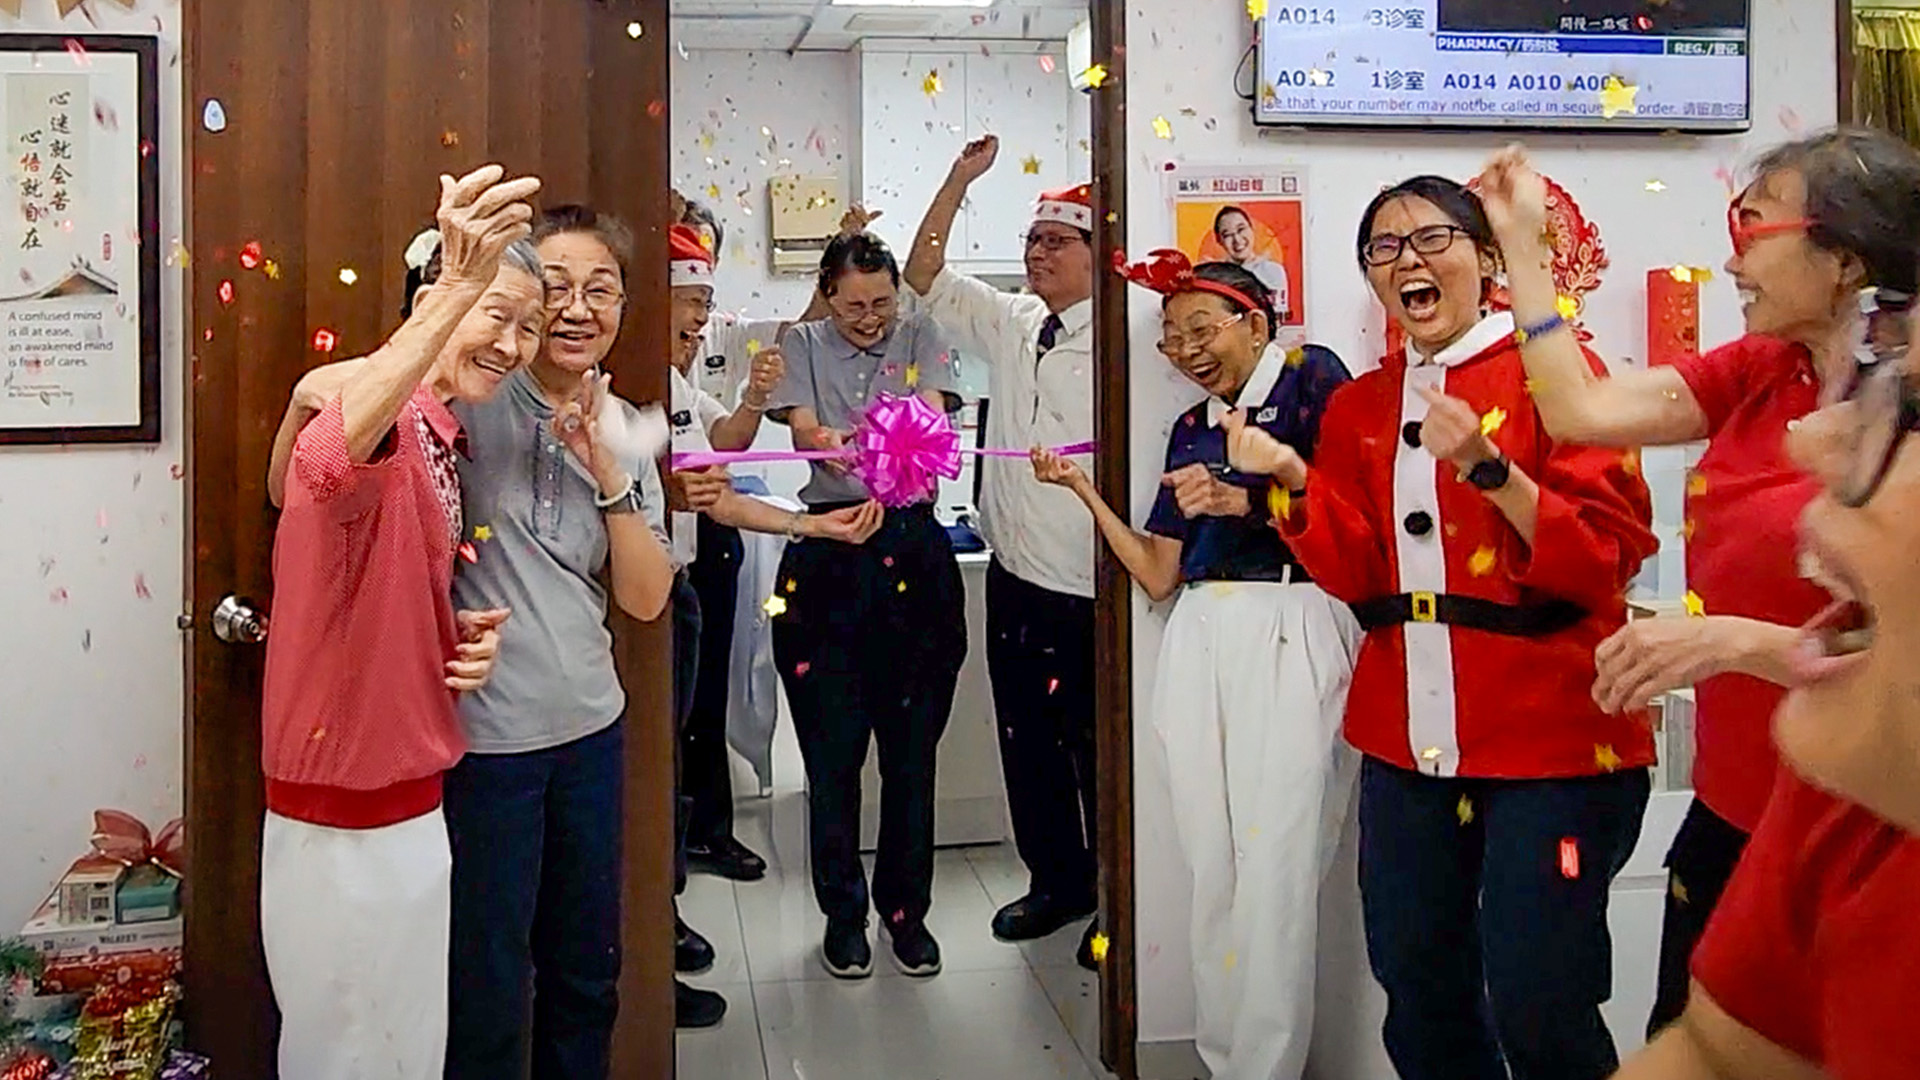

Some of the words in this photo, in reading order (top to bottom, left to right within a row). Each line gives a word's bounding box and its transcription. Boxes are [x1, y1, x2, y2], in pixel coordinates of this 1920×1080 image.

[1278, 7, 1335, 24] A014
[1371, 8, 1425, 29] 3诊室
[1371, 70, 1425, 90] 1诊室
[1443, 74, 1496, 90] A014
[1508, 75, 1561, 91] A010
[1573, 75, 1625, 91] A00
[1287, 97, 1316, 109] that
[1322, 98, 1351, 111] your
[1358, 97, 1412, 110] number
[1417, 101, 1445, 113] may
[1452, 99, 1475, 111] not
[1480, 99, 1496, 111] be
[1501, 99, 1540, 112] called
[1546, 101, 1558, 111] in
[8, 312, 16, 320] A
[19, 311, 70, 320] confused
[73, 311, 102, 320] mind
[8, 328, 16, 336] is
[19, 327, 28, 336] ill
[32, 327, 42, 336] at
[8, 343, 22, 352] an
[25, 341, 82, 351] awakened
[84, 341, 113, 351] mind
[8, 358, 16, 367] is
[44, 356, 55, 367] of
